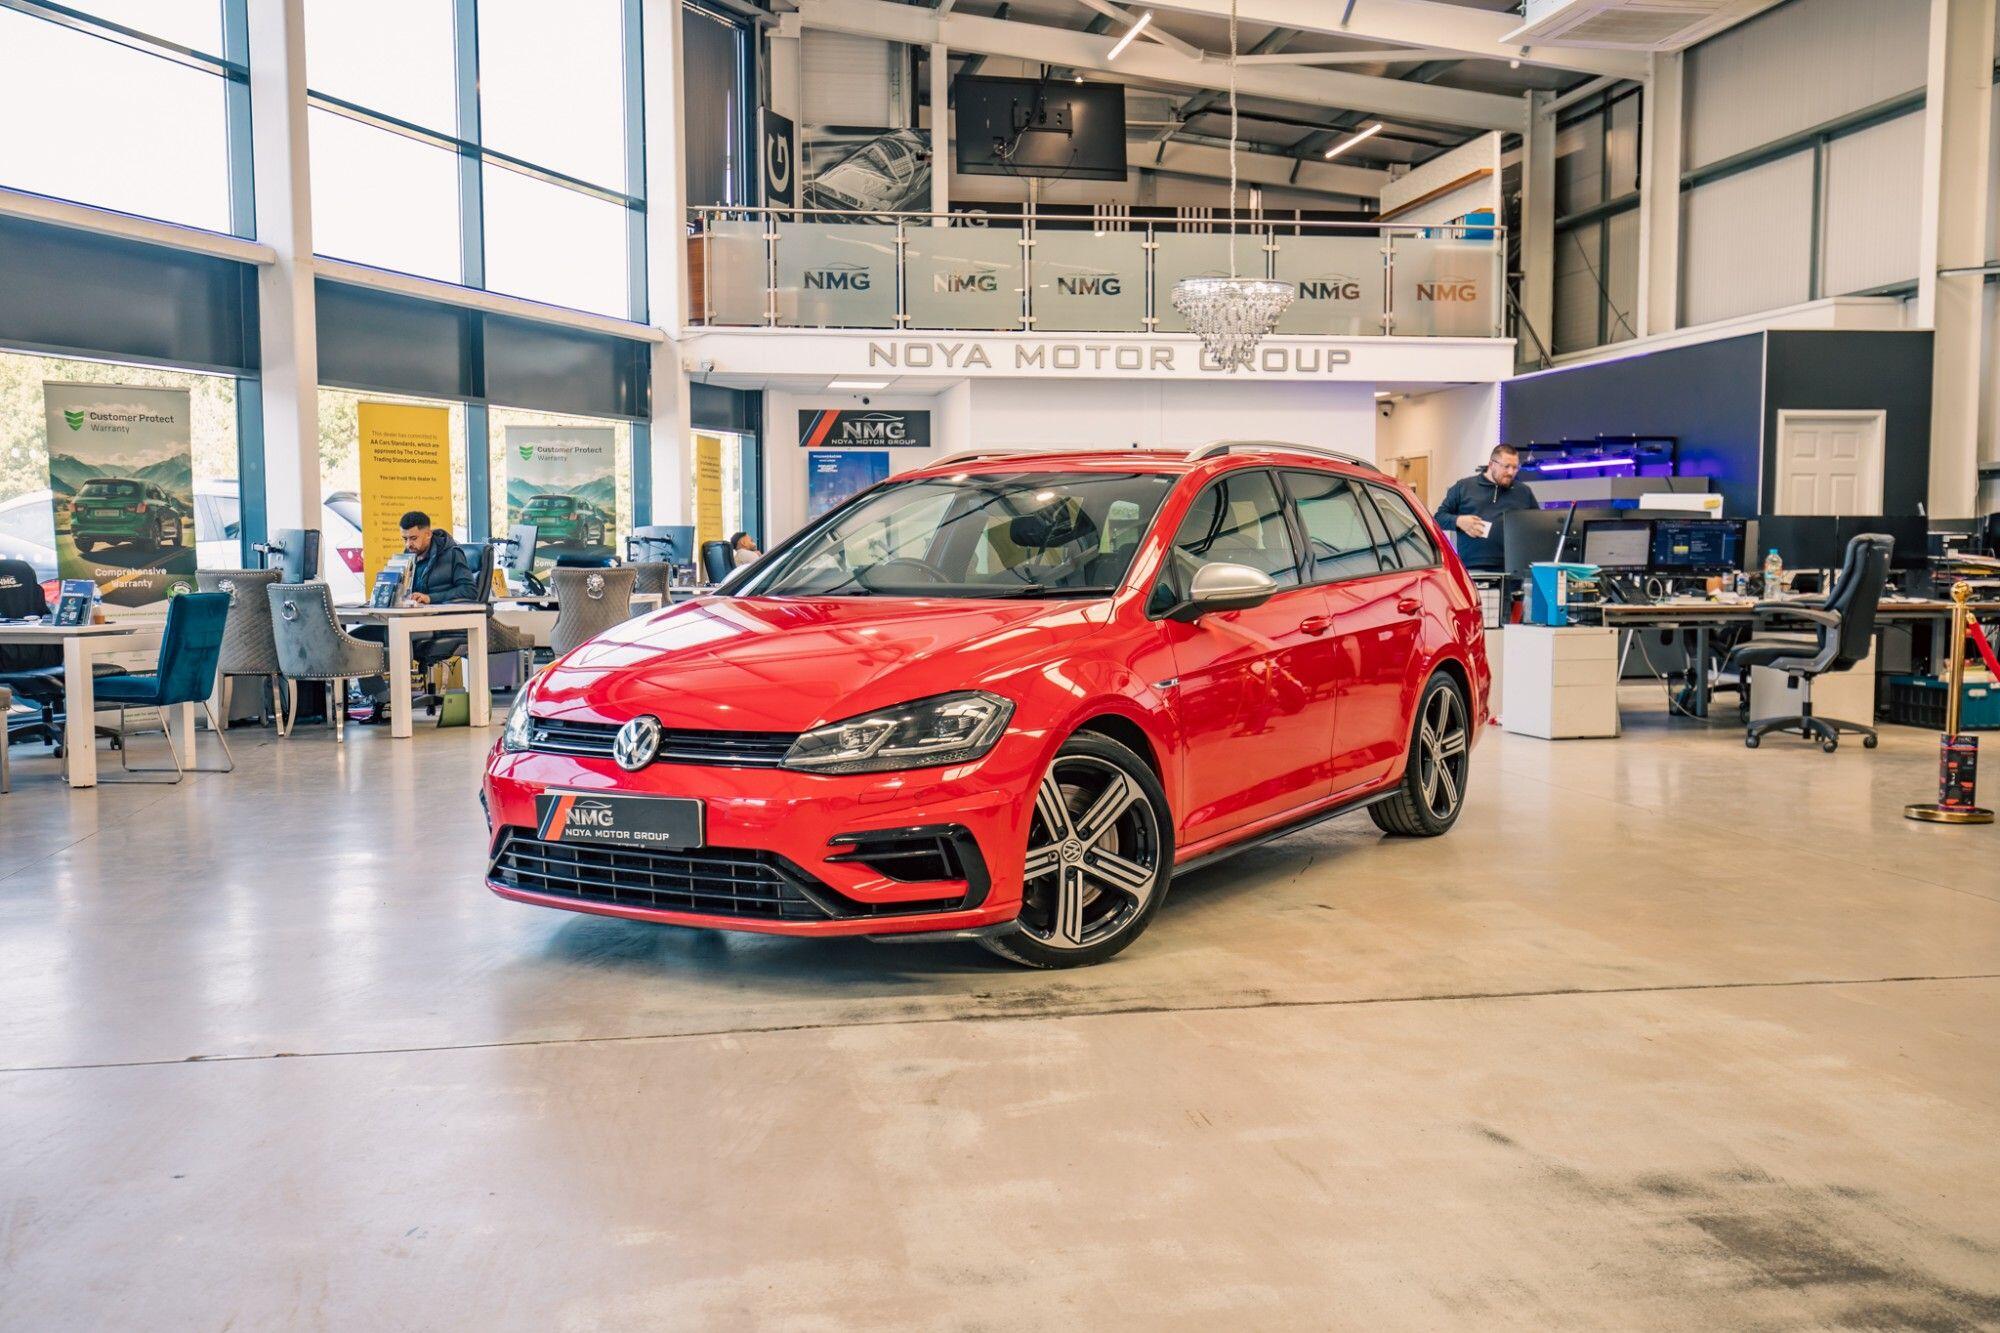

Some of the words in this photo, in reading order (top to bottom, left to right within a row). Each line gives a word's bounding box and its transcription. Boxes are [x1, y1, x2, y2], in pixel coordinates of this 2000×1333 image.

[804, 272, 870, 290] NMG
[933, 274, 998, 292] NMG
[1057, 277, 1121, 295] NMG
[1300, 282, 1360, 300] NMG
[1417, 284, 1476, 301] NMG
[869, 342, 992, 368] NOYA
[1015, 344, 1176, 370] MOTOR
[1199, 348, 1351, 372] GROUP
[90, 411, 137, 422] Customer
[139, 414, 175, 424] Protect
[91, 424, 130, 434] Warranty
[842, 422, 905, 439] NMG
[537, 446, 573, 454] Customer
[574, 446, 603, 454] Protect
[95, 567, 168, 578] Comprehensive
[565, 808, 614, 827] NMG
[565, 828, 592, 837] NOYA
[595, 829, 631, 839] MOTOR
[633, 831, 670, 841] GROUP
